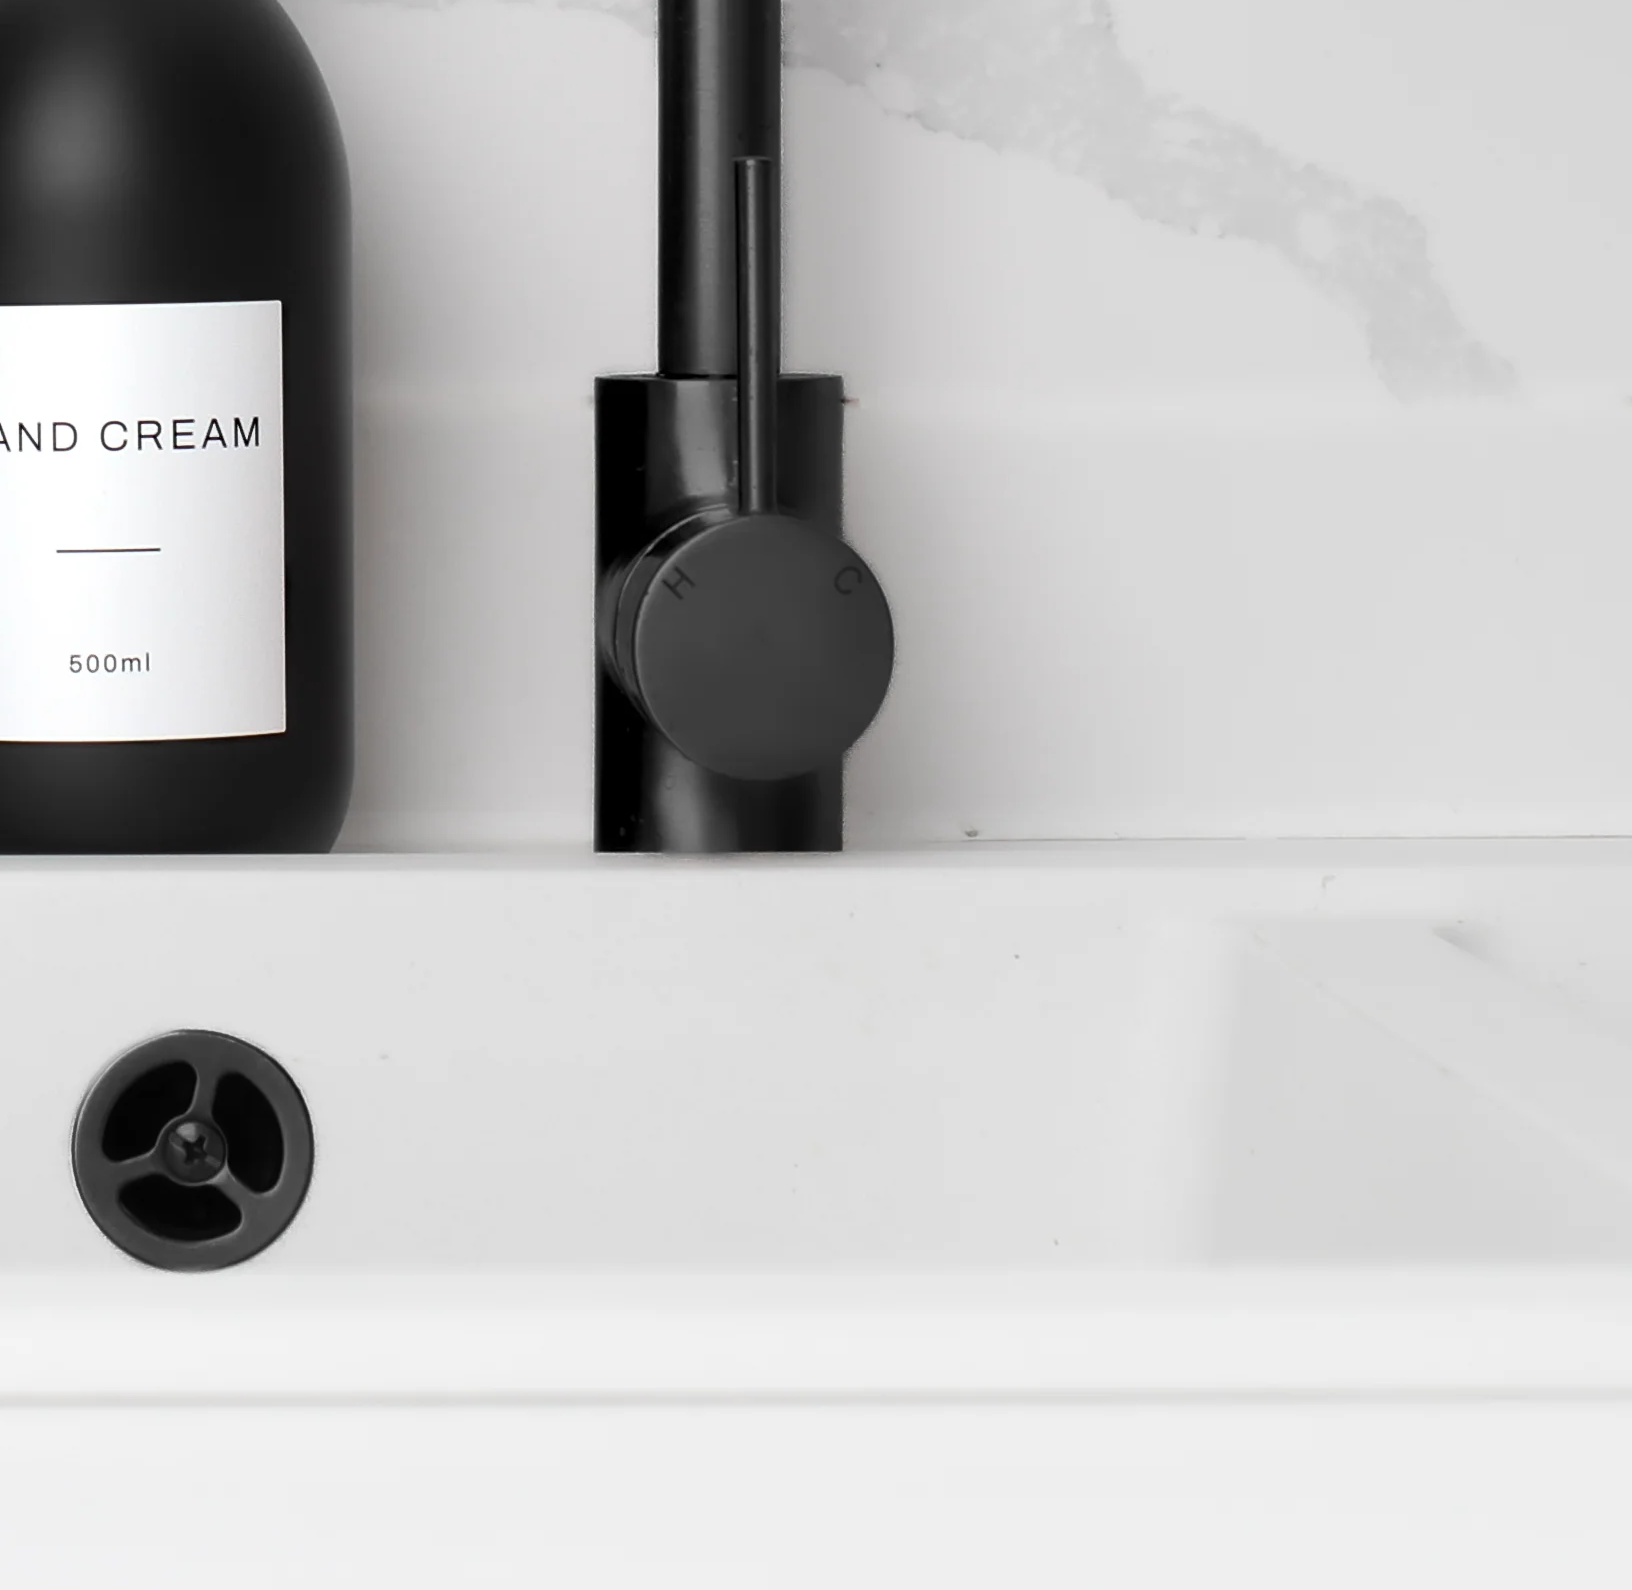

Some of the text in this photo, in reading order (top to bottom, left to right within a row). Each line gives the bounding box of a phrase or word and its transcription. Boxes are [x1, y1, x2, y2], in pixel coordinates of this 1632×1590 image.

[99, 415, 261, 453] CREAM
[661, 565, 696, 601] H
[833, 564, 863, 597] C
[68, 651, 151, 674] 500ml
